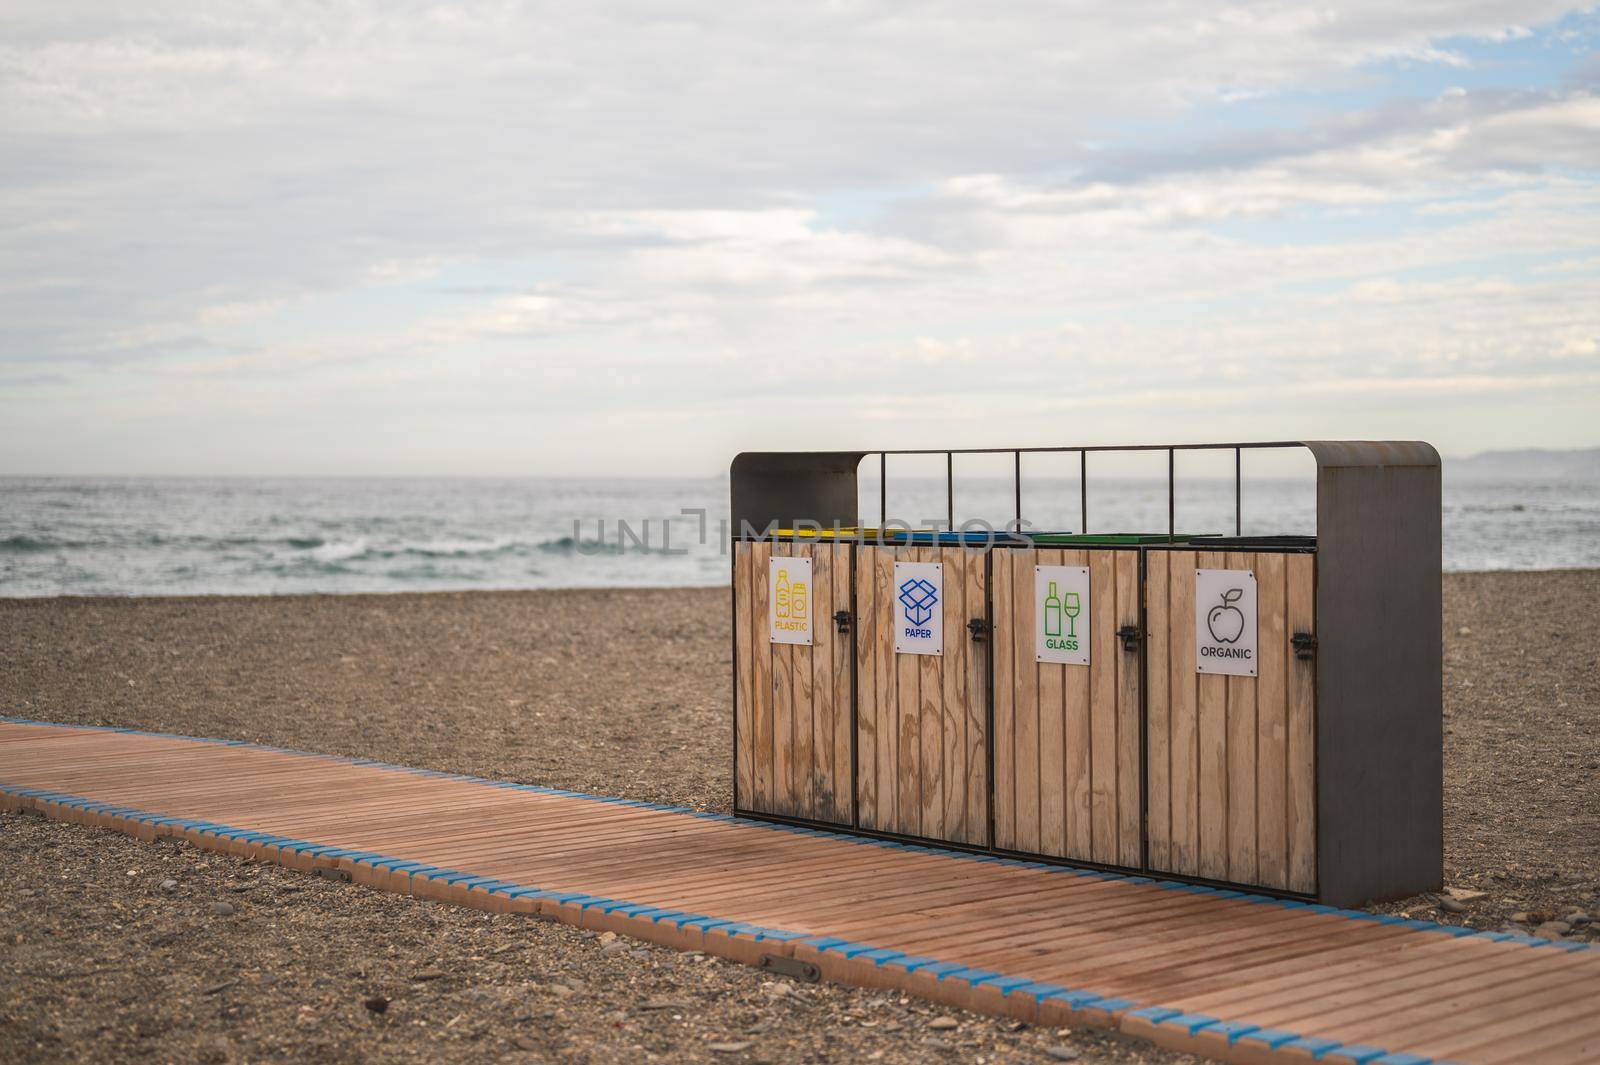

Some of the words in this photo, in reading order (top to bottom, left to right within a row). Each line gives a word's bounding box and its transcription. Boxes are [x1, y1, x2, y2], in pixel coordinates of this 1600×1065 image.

[775, 621, 808, 632] PLASTIC
[905, 628, 932, 639] PAPER
[1046, 639, 1079, 651] GLASS
[1200, 646, 1252, 659] ORGANIC
